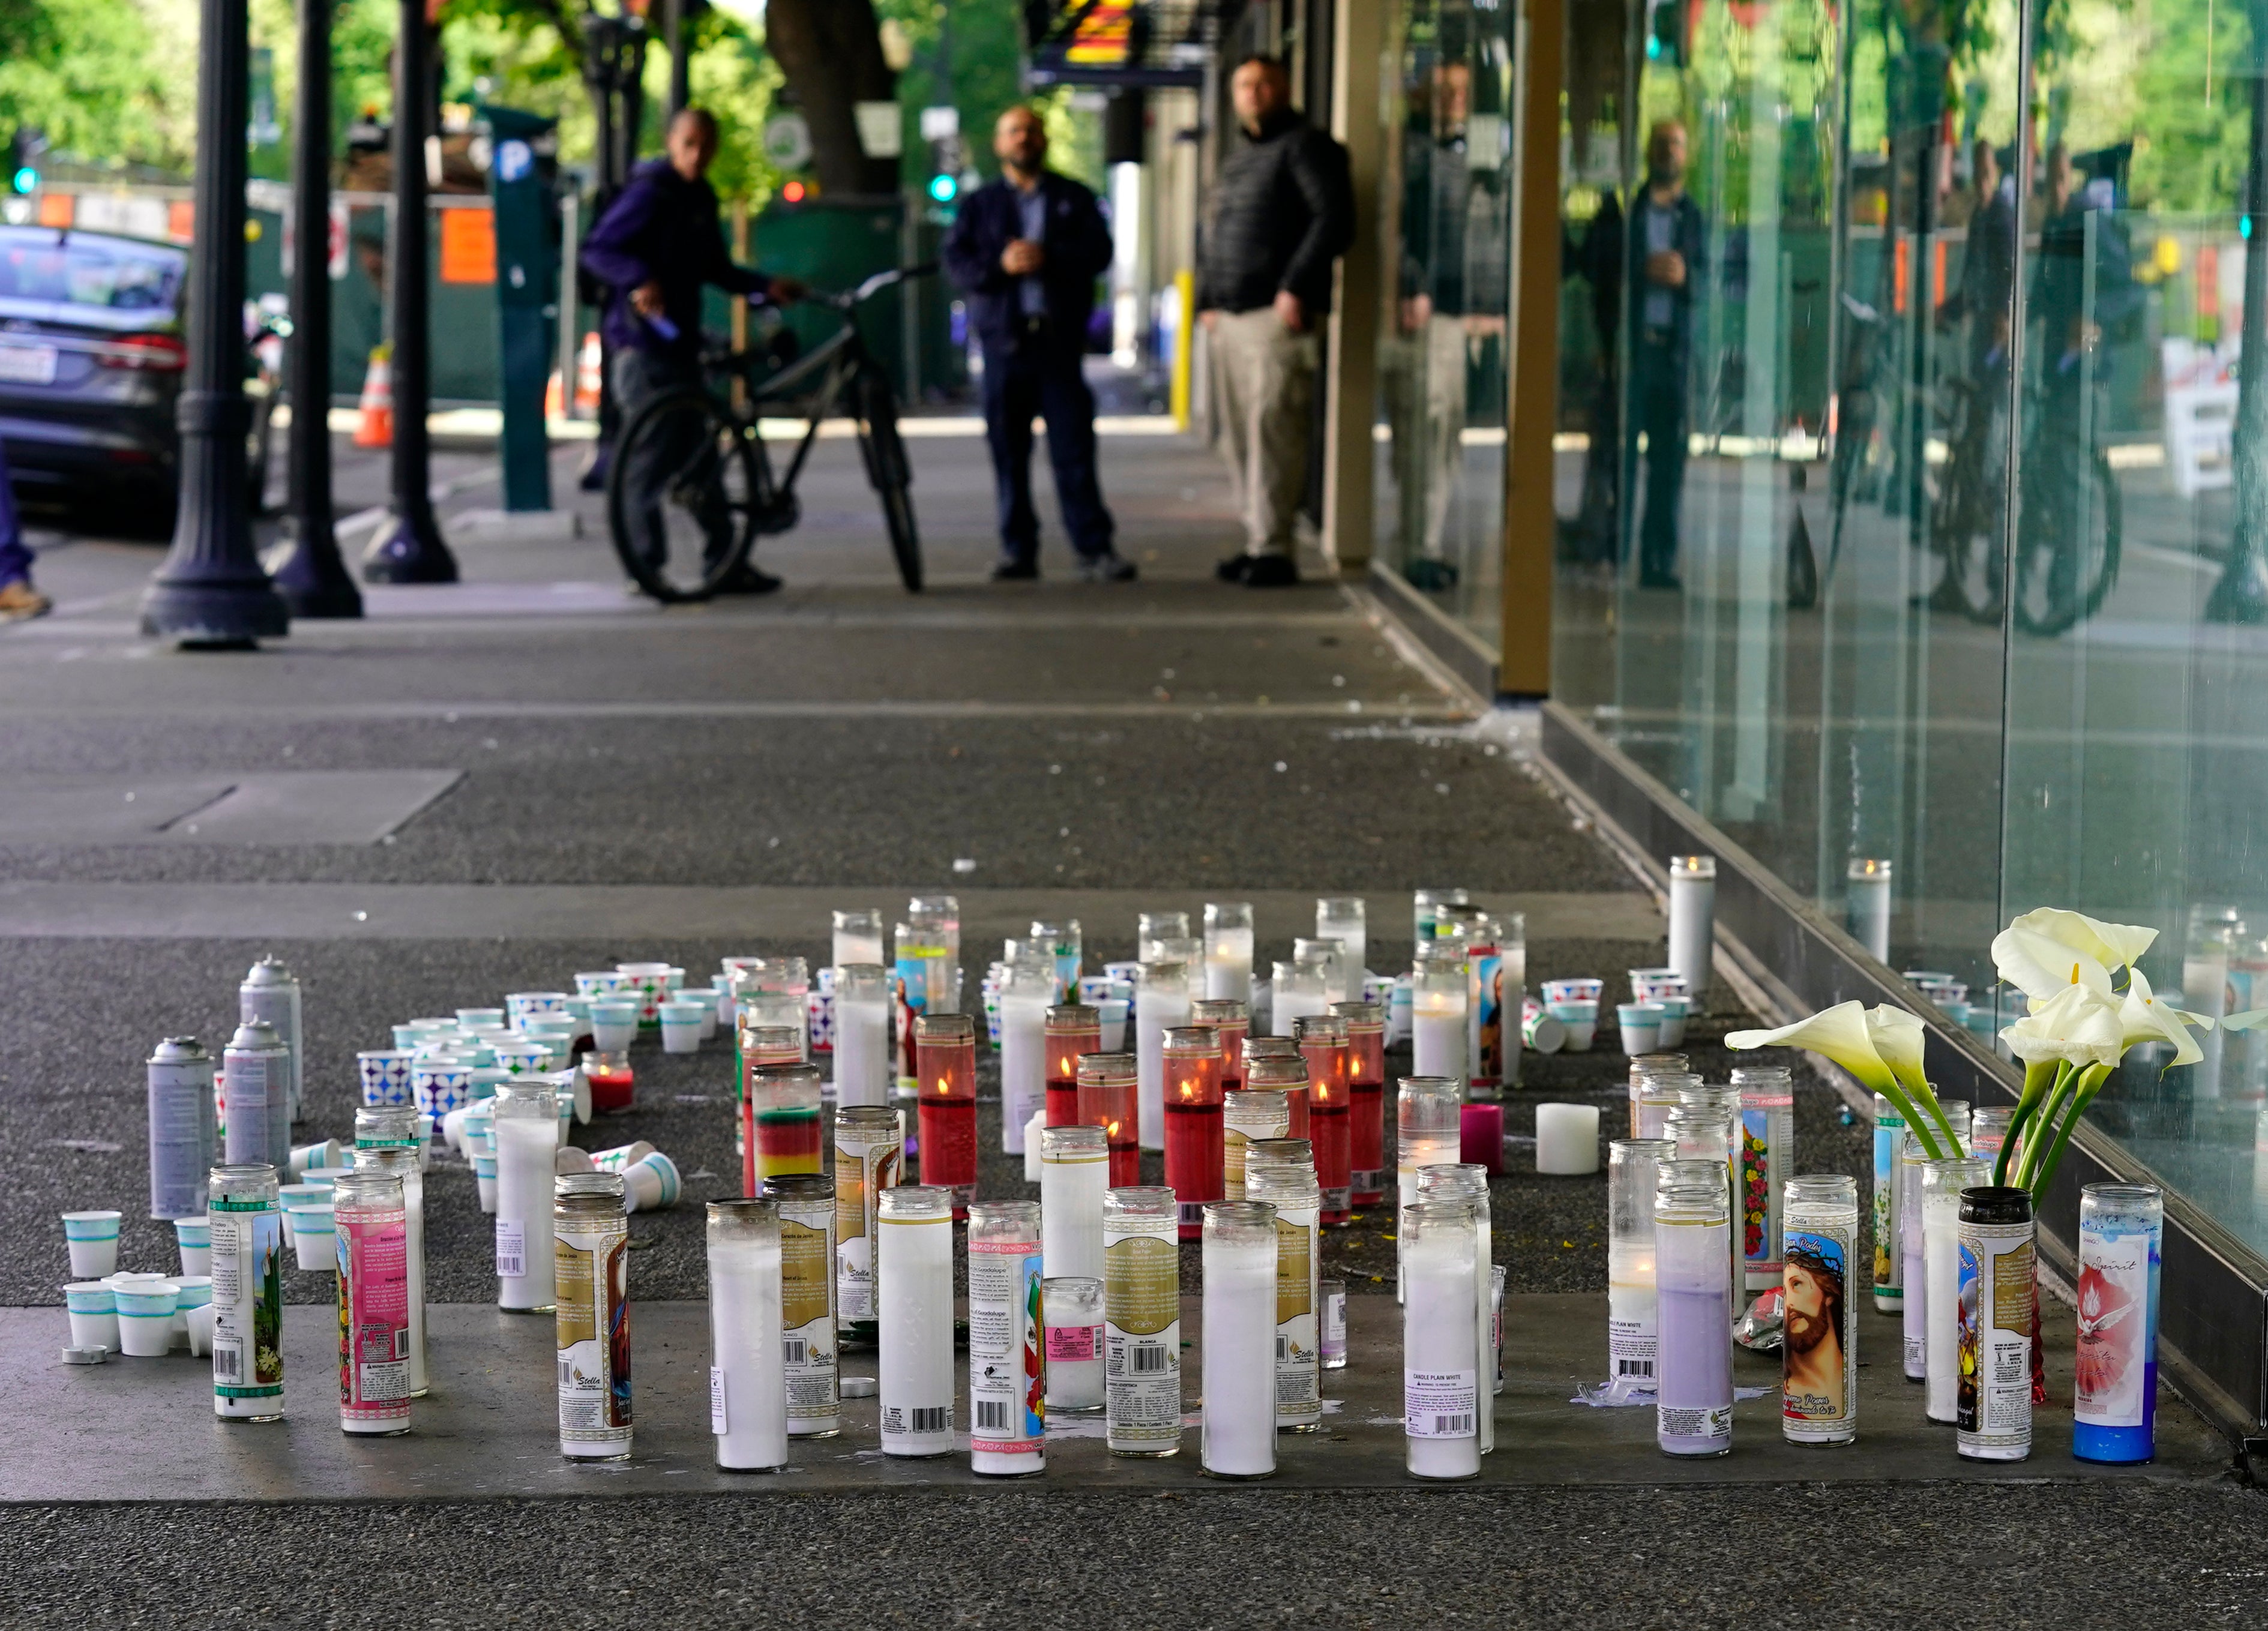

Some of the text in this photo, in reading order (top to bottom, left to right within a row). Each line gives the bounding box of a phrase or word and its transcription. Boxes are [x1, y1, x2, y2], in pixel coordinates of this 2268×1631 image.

[501, 140, 531, 181] P
[1799, 1237, 1822, 1253] Poder
[2092, 1256, 2137, 1275] Spirit
[814, 1353, 832, 1362] Stella
[1295, 1350, 1314, 1359] Stella
[577, 1377, 600, 1385] Stella
[1804, 1393, 1829, 1406] Power
